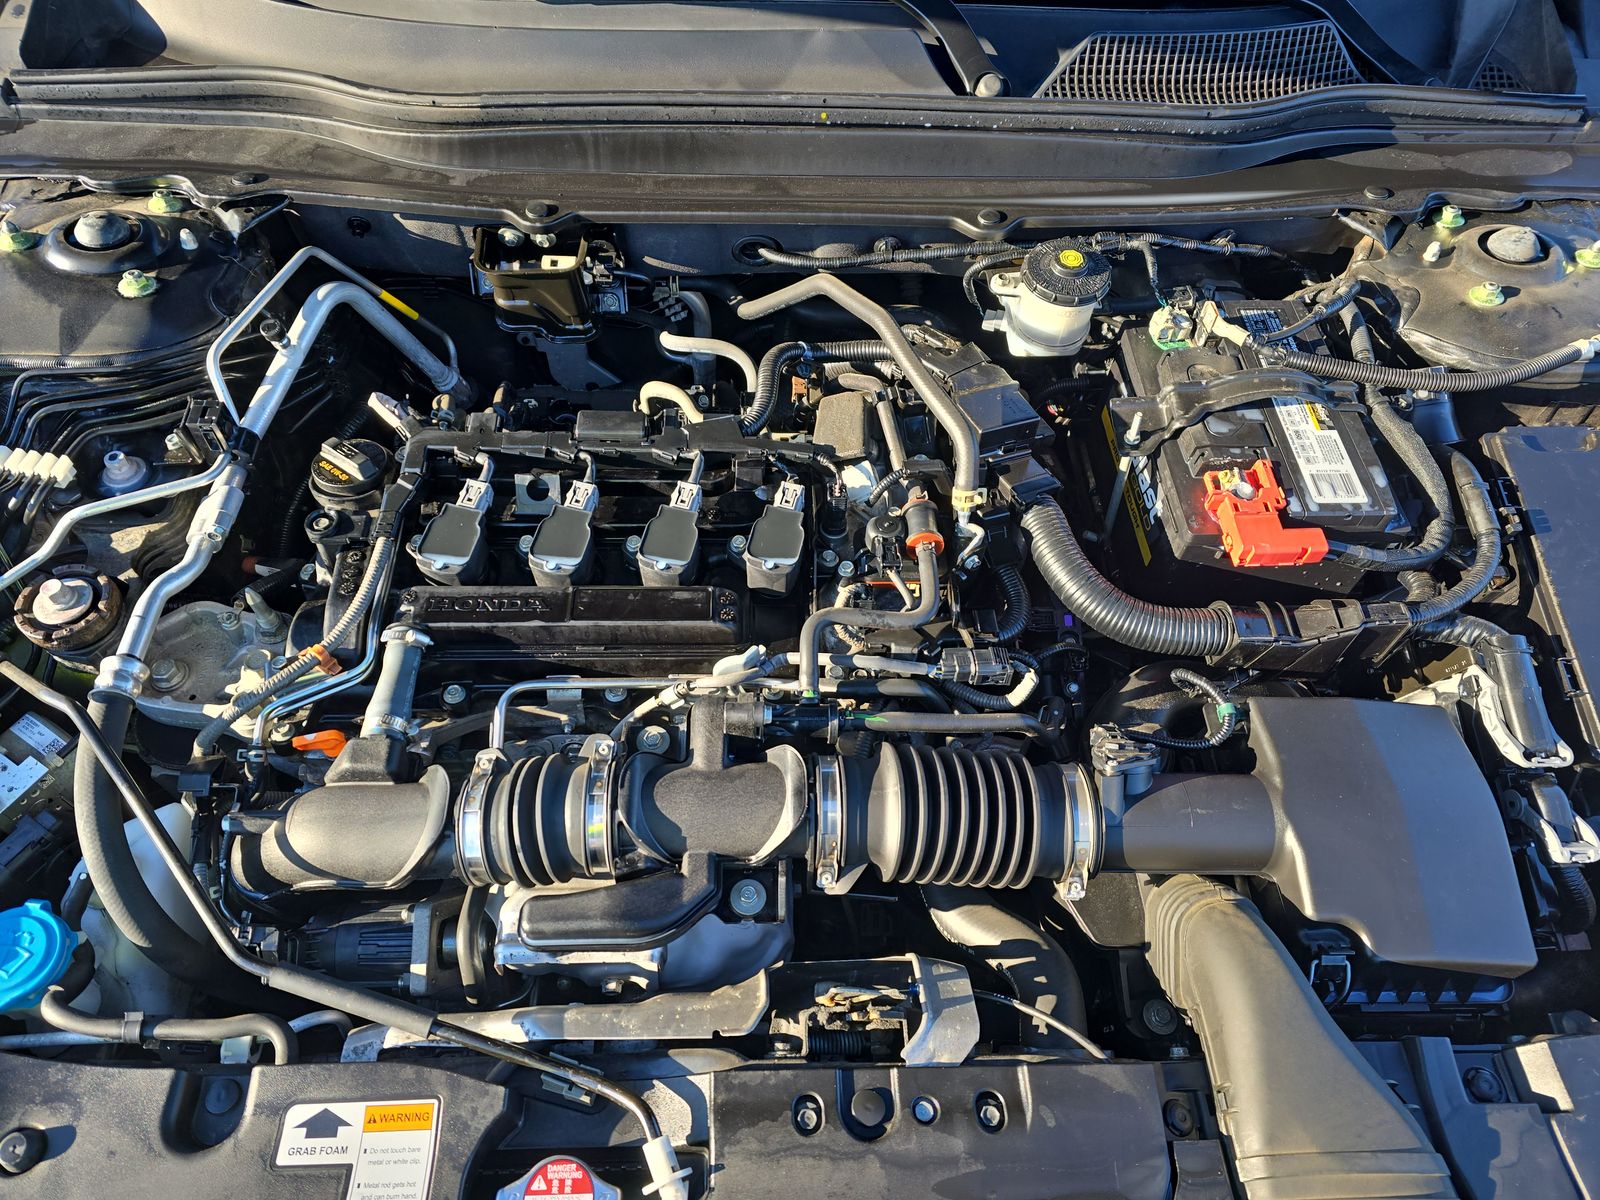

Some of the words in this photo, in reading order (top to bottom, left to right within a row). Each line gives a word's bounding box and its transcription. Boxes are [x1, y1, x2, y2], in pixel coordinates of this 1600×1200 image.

[1130, 472, 1151, 531] GOLD
[424, 597, 551, 612] HONDA
[379, 1111, 430, 1124] WARNING
[287, 1146, 317, 1157] GRAB
[318, 1145, 349, 1156] FOAM
[547, 1163, 577, 1172] DANGER
[363, 1181, 380, 1189] Metal
[391, 1181, 405, 1190] gets
[406, 1180, 416, 1188] hot
